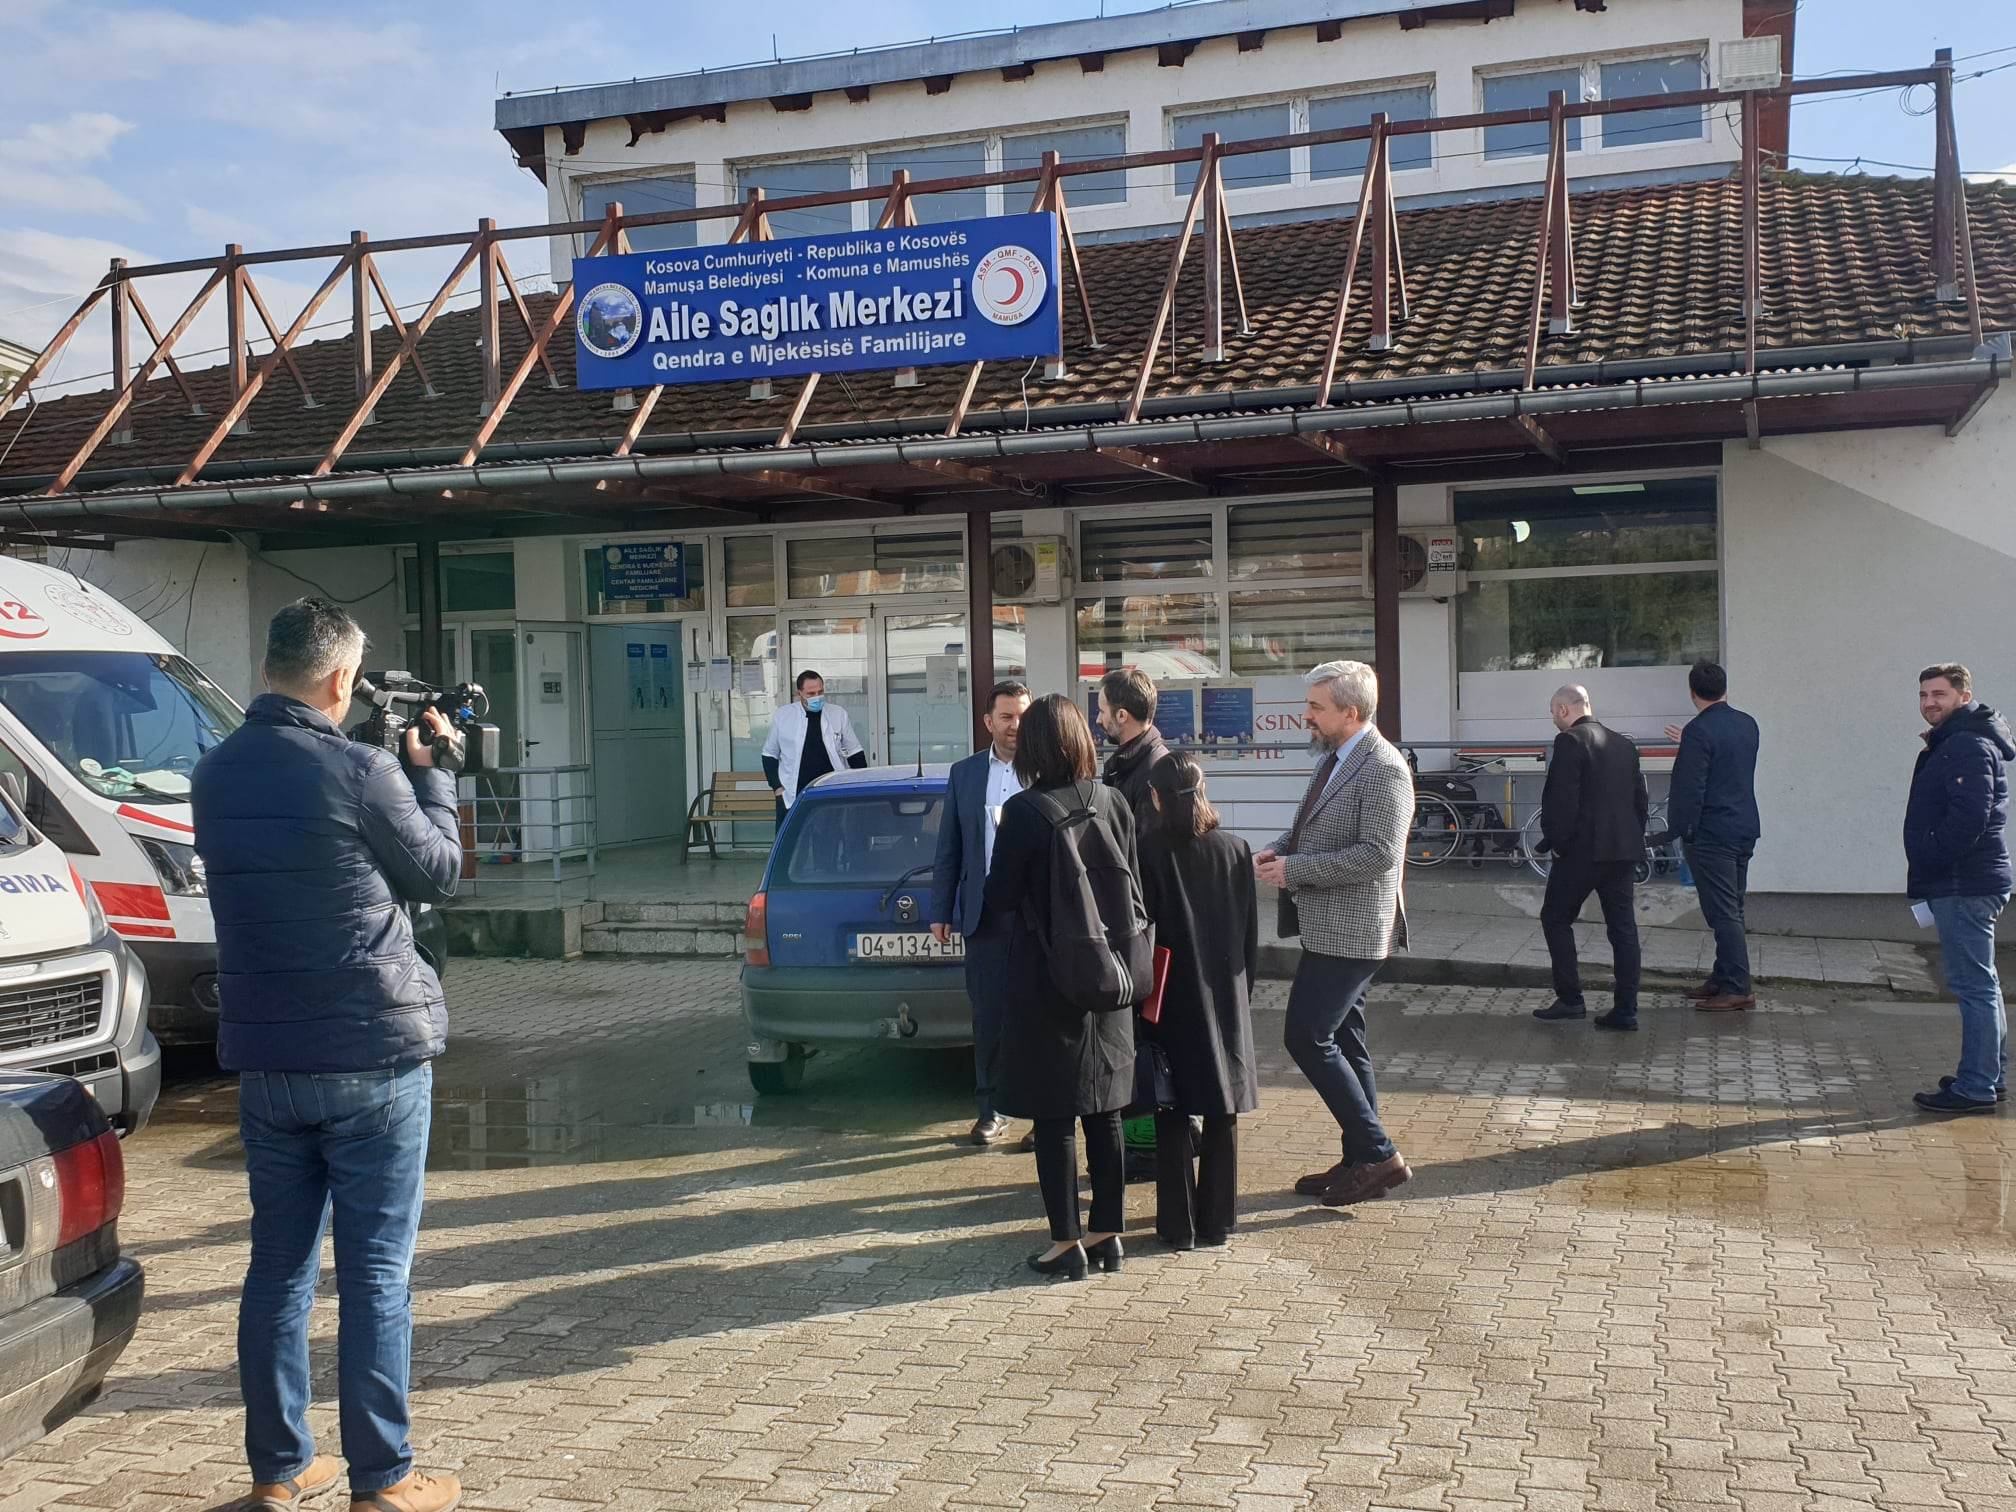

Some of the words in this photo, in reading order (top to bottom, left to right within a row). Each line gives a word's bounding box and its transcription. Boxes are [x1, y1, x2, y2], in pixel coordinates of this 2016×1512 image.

[644, 279, 704, 295] Mamuşa
[708, 269, 784, 290] Belediyesi
[806, 263, 869, 281] Komuna
[873, 264, 882, 275] e
[887, 252, 970, 273] Mamushës
[646, 259, 700, 275] Kosova
[704, 247, 793, 270] Cumhuriyeti
[807, 240, 882, 262] Republika
[886, 240, 895, 252] e
[900, 231, 967, 250] Kosovës
[977, 259, 992, 280] ASM
[997, 249, 1017, 258] QMF
[1023, 255, 1040, 275] PCM
[648, 301, 710, 343] Aile
[719, 294, 821, 341] Saglık
[829, 278, 962, 329] Merkezi
[653, 349, 725, 370] Qendra
[731, 350, 744, 364] e
[750, 338, 854, 366] Mjekësisë
[861, 331, 967, 354] Familijare
